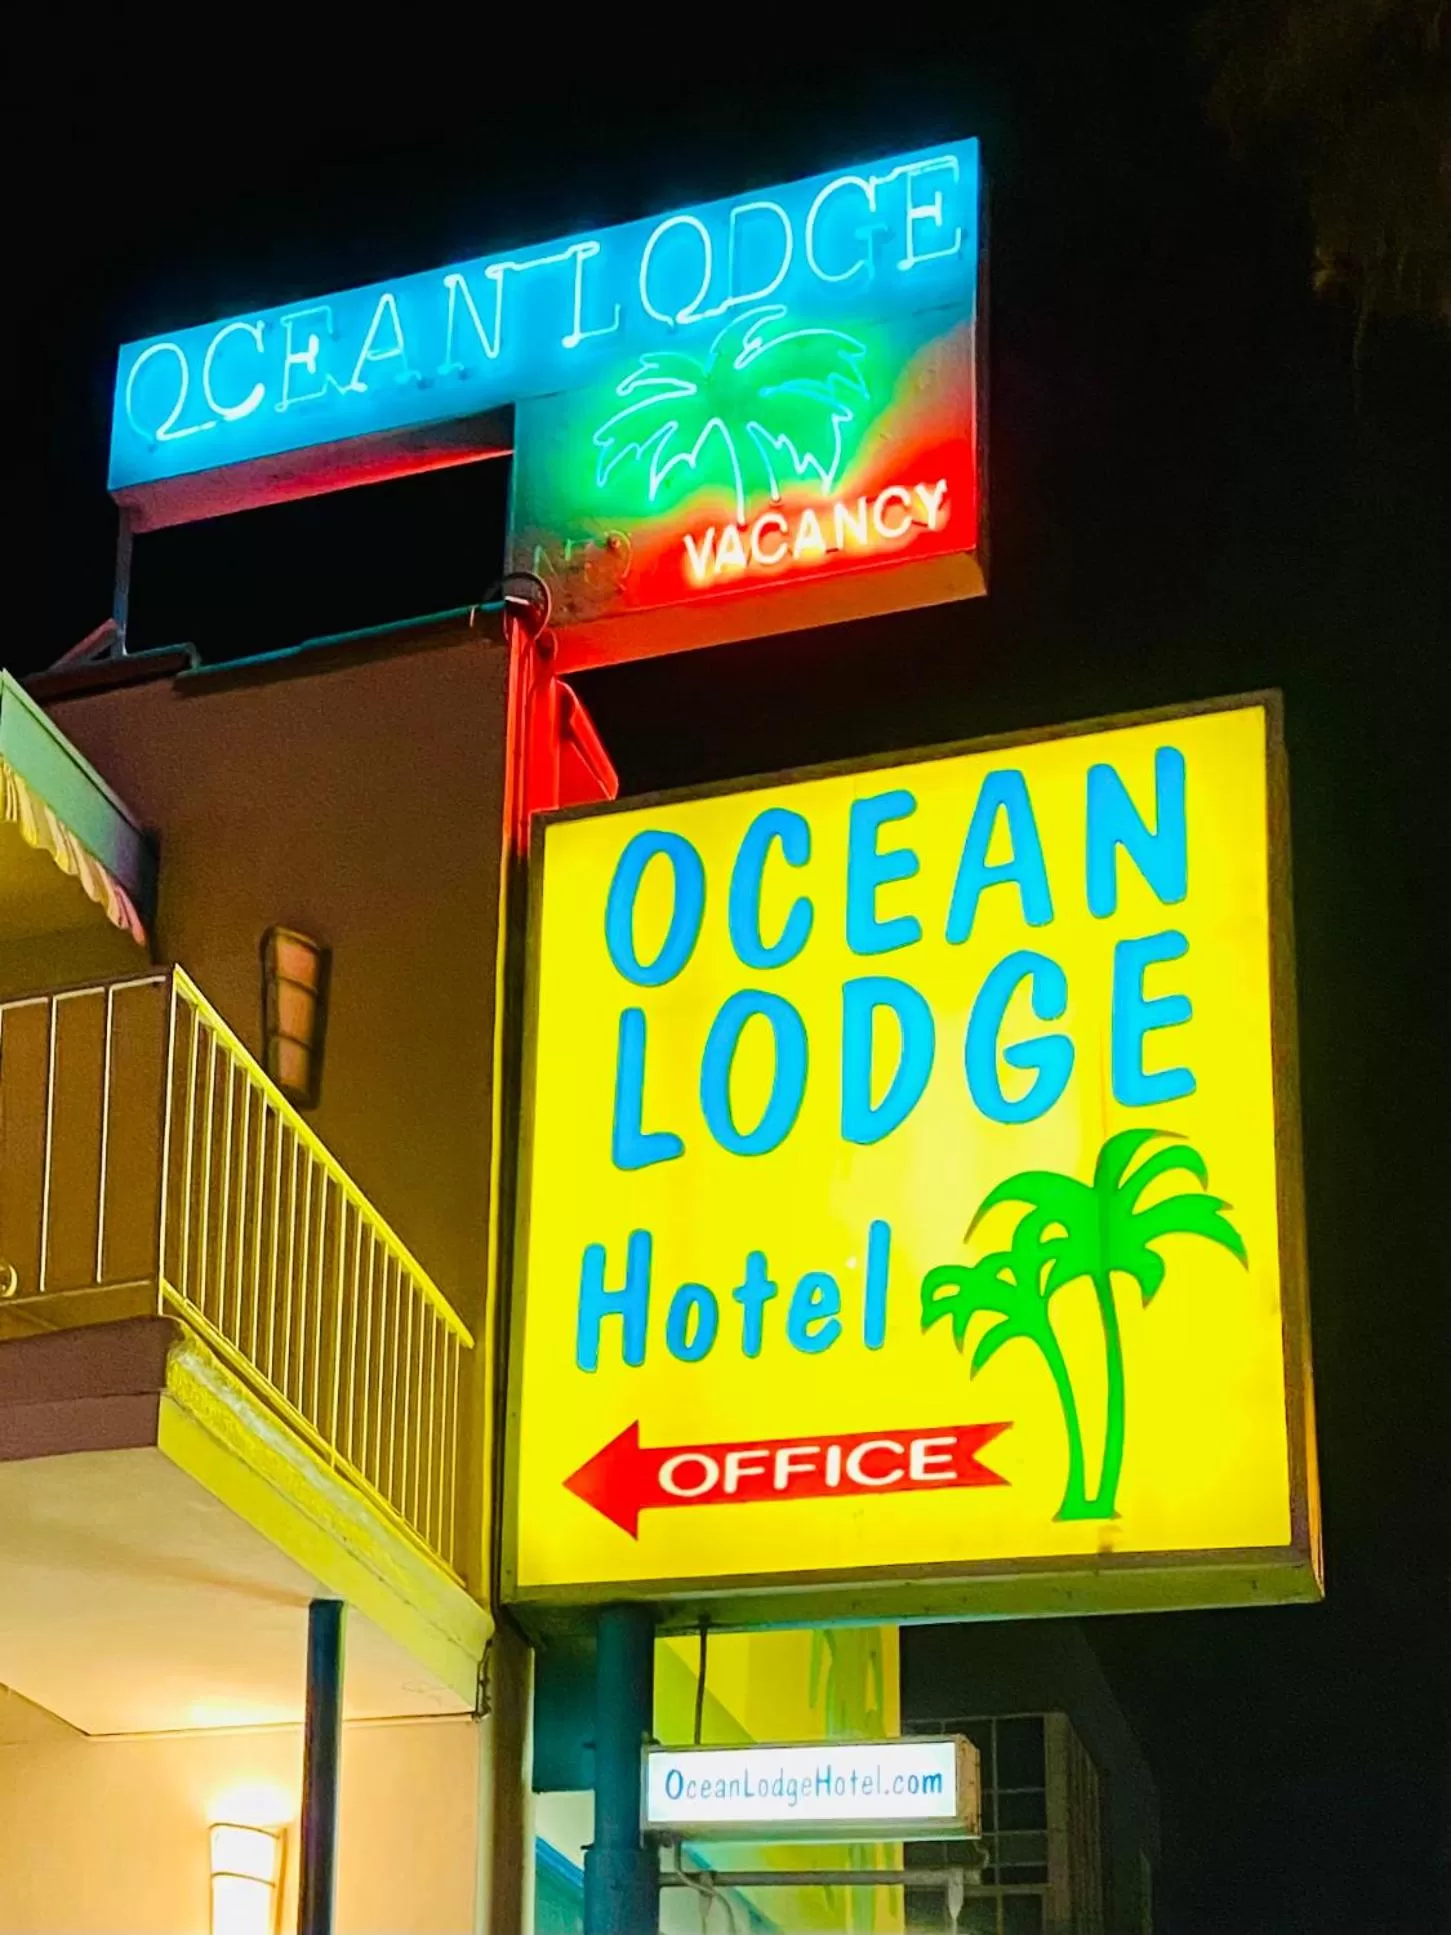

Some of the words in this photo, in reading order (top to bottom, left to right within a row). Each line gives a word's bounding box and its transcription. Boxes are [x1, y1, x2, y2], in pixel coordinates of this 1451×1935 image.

[125, 264, 506, 443] OCEAN
[560, 155, 962, 349] LODGE
[683, 480, 948, 580] VACANCY
[604, 746, 1188, 987] OCEAN
[611, 930, 1197, 1171] LODGE
[576, 1219, 892, 1374] Hotel
[658, 1436, 957, 1498] OFFICE
[665, 1765, 943, 1806] OceanLodgeHotel.com
